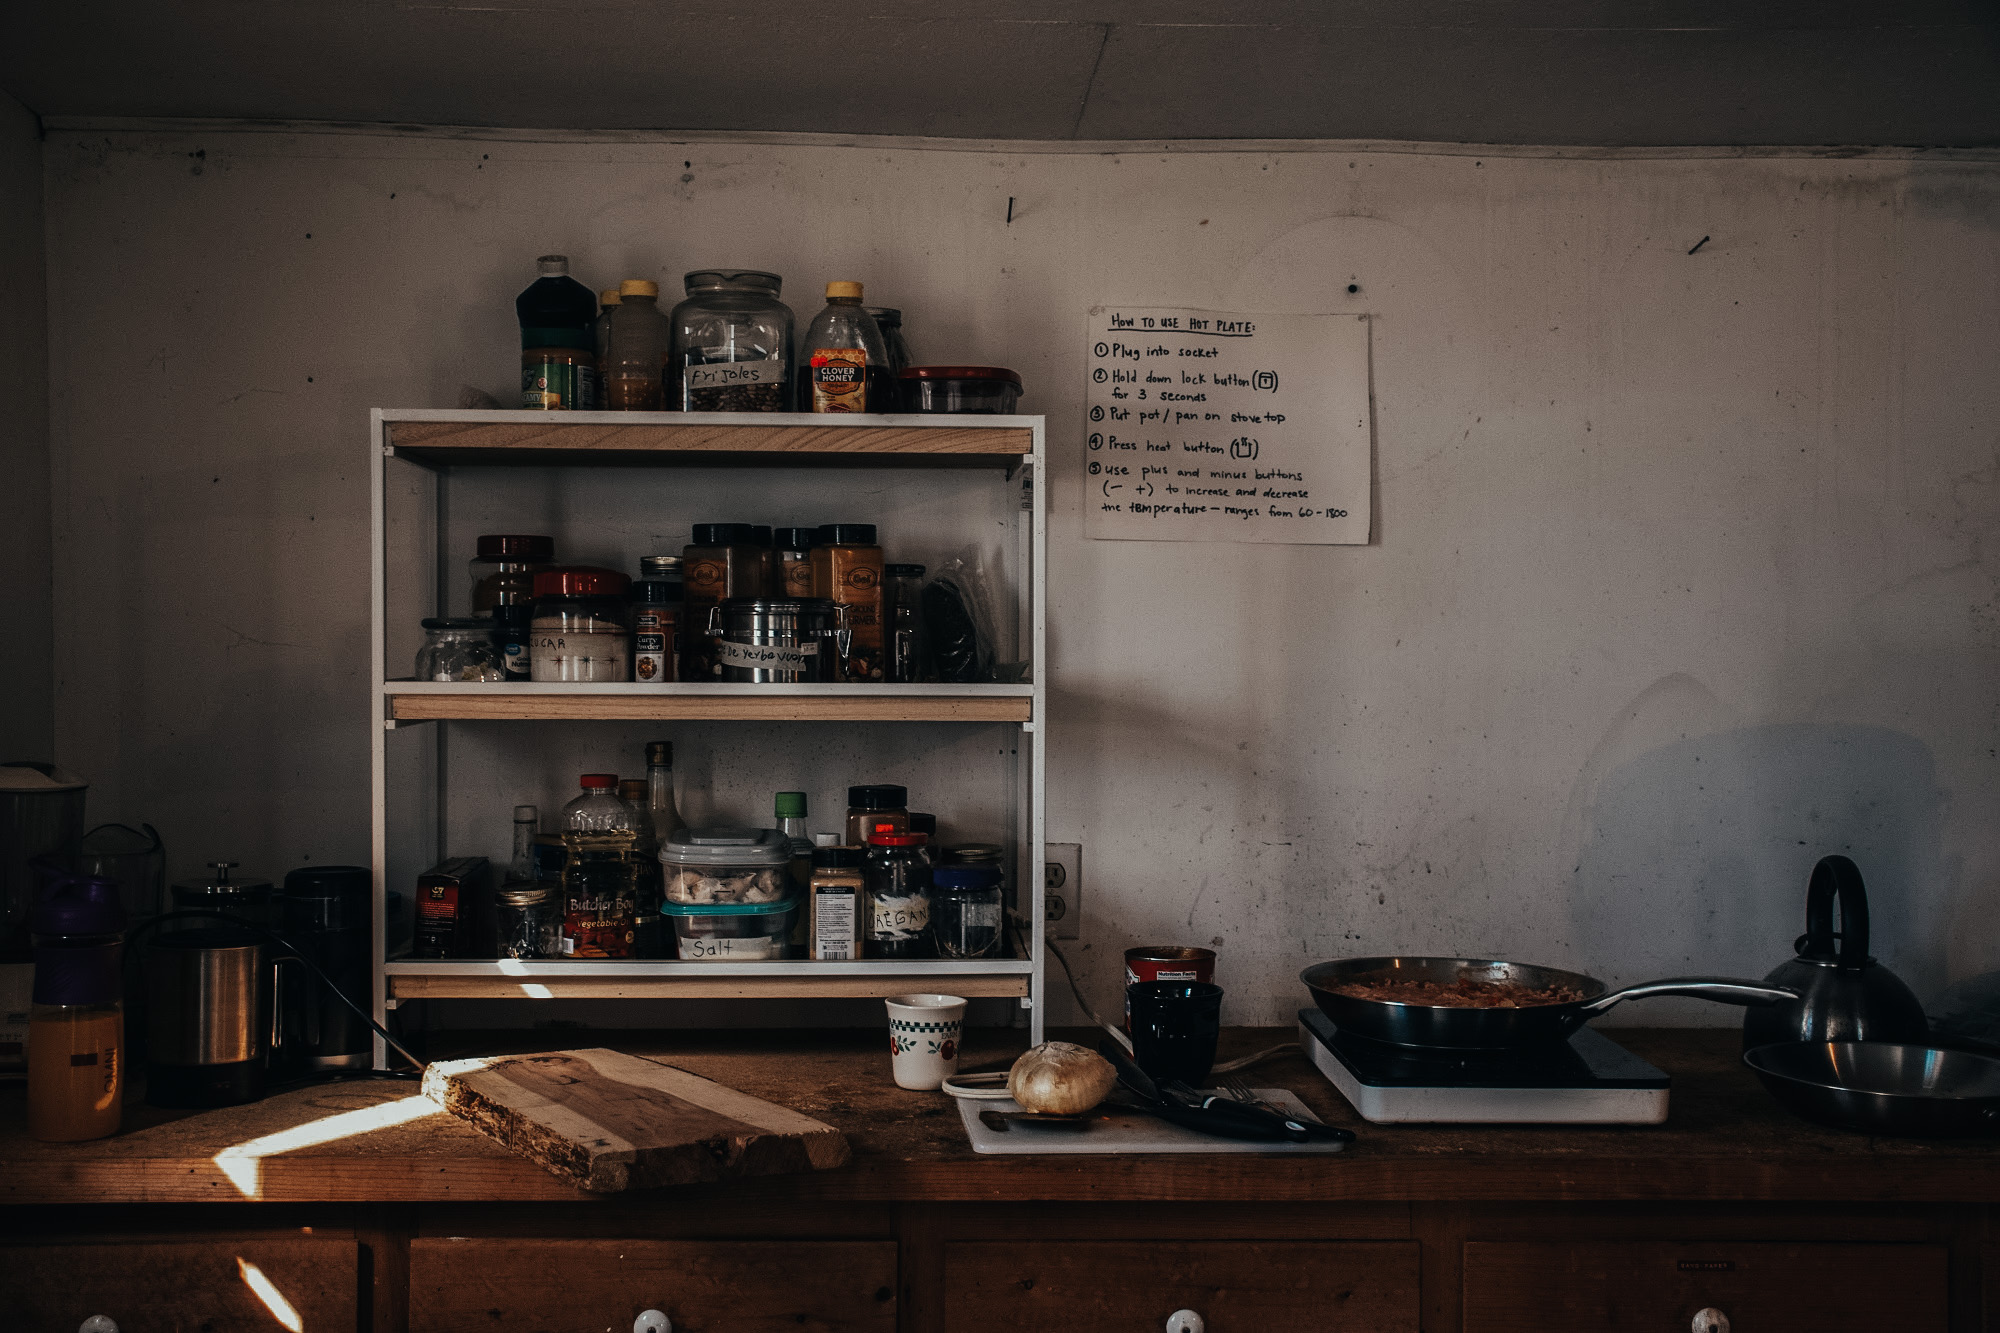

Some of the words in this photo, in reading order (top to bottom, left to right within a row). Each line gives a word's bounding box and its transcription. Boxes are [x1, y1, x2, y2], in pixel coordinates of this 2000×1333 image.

[1141, 318, 1154, 327] TO
[1189, 317, 1209, 330] HOT
[1113, 343, 1140, 361] Plug
[1147, 345, 1169, 356] into
[1179, 348, 1218, 357] socket
[821, 367, 855, 375] CLOVER
[822, 374, 854, 382] HONEY
[1113, 369, 1136, 383] Hold
[1146, 371, 1171, 383] down
[1182, 370, 1206, 384] lock
[1112, 387, 1128, 399] for
[1138, 389, 1147, 400] 3
[1160, 392, 1206, 402] seconds
[1110, 407, 1130, 420] Put
[1176, 412, 1198, 424] pan
[1109, 436, 1136, 450] Press
[1147, 440, 1170, 451] heat
[1184, 441, 1224, 454] button
[1142, 465, 1168, 481] plus
[1178, 468, 1199, 477] and
[1211, 471, 1246, 479] minus
[1255, 469, 1302, 481] buttons
[1166, 484, 1178, 494] to
[1186, 488, 1229, 496] increase
[1236, 488, 1256, 496] and
[1263, 488, 1308, 498] decrease
[1225, 507, 1259, 520] ranges
[1269, 505, 1292, 517] from
[636, 642, 660, 650] Powder
[637, 635, 658, 647] Curry
[570, 896, 613, 911] Butcher
[615, 897, 634, 914] Boy
[577, 919, 618, 929] Vegetable
[692, 940, 733, 957] Salt
